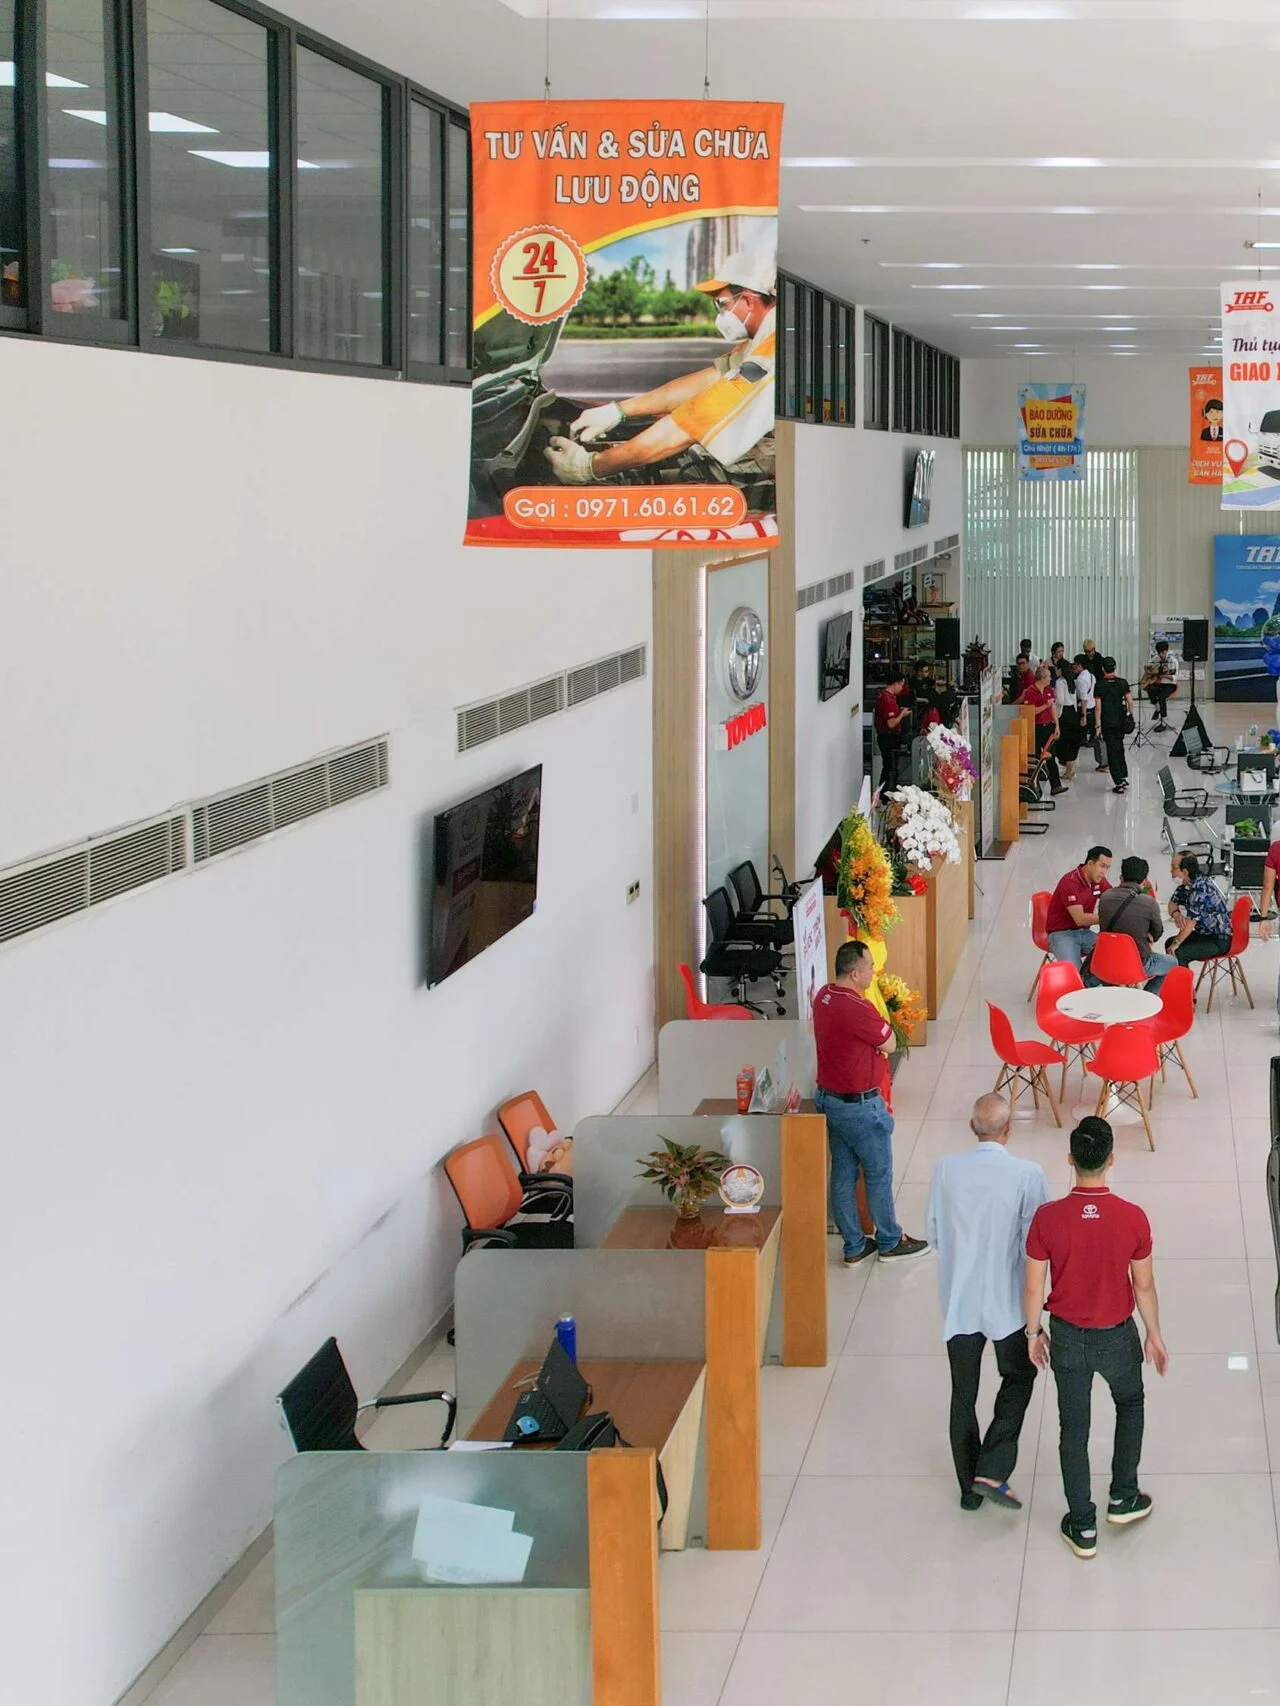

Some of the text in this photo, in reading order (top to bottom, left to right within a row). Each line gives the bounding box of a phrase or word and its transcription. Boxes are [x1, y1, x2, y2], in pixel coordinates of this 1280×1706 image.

[484, 120, 770, 160] TƯ VẤN & SỬA CHỮA
[554, 168, 701, 209] LƯU ĐỘNG
[522, 240, 558, 275] 24
[532, 280, 546, 314] 7
[1234, 290, 1269, 305] TAF
[1232, 336, 1258, 352] Thủ
[1229, 362, 1271, 382] GIAO
[514, 496, 735, 526] Gọi : 0971.60.61.62
